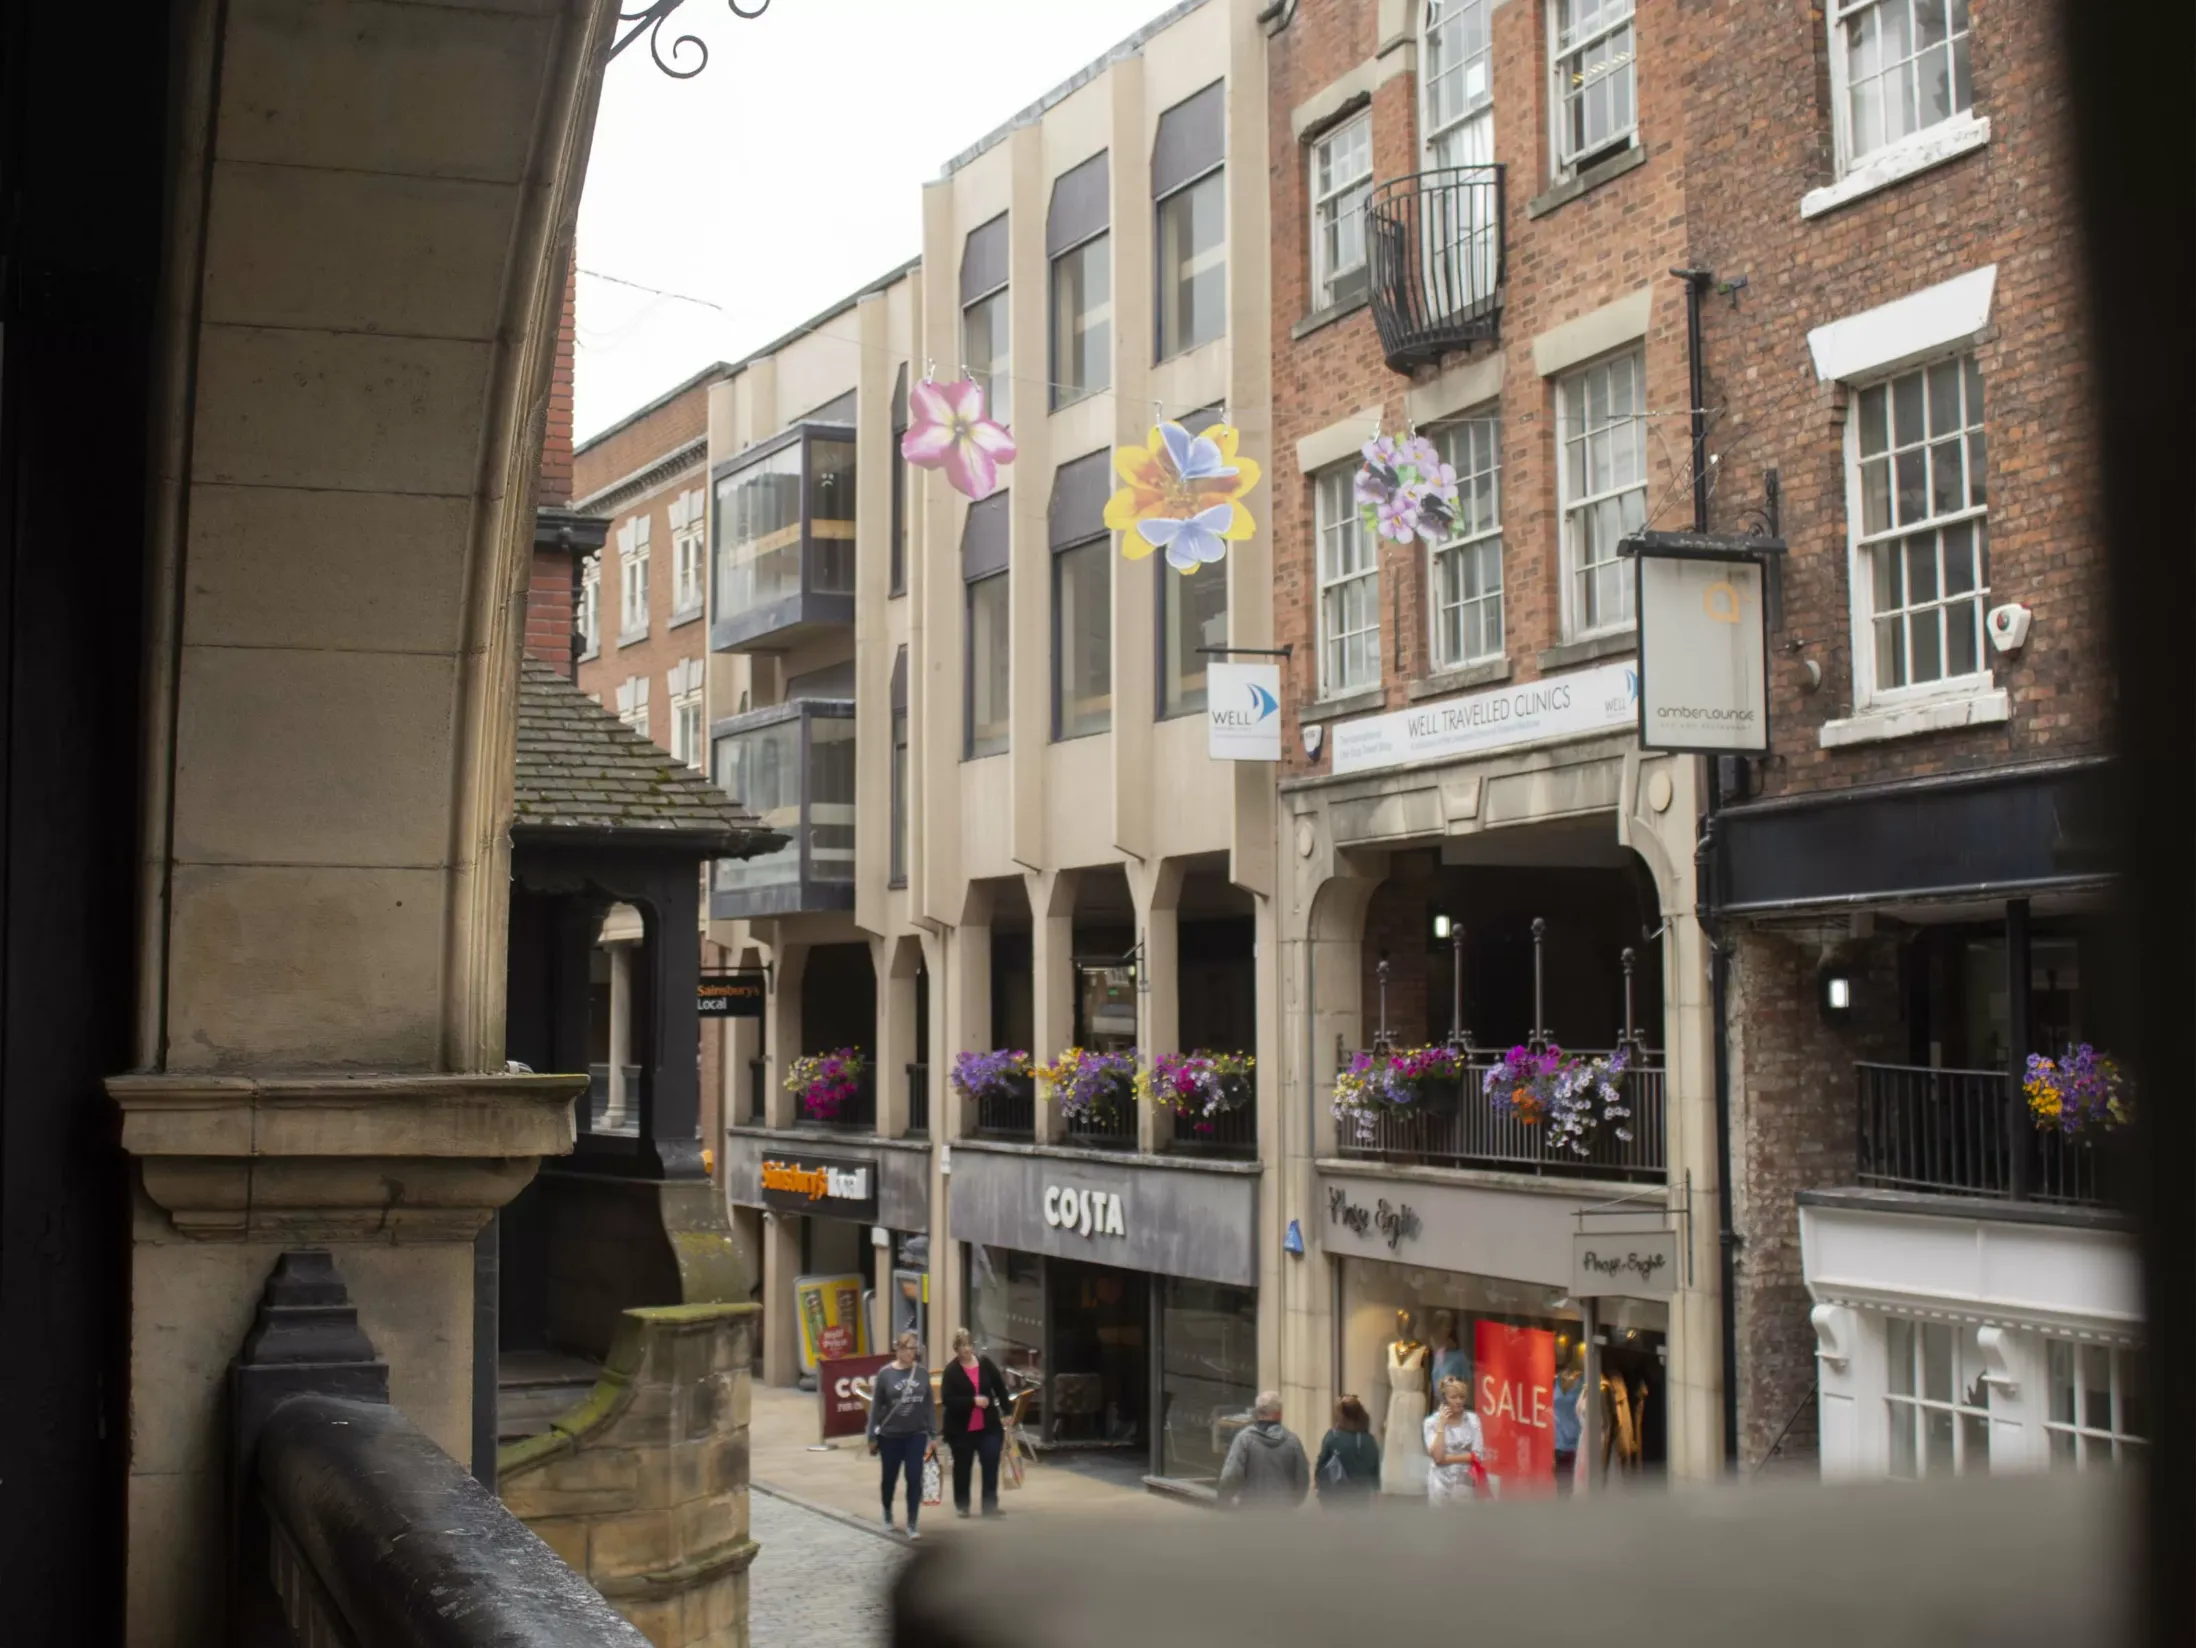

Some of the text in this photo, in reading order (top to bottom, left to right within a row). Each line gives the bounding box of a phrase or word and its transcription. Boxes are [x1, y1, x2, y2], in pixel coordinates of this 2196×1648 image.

[1211, 710, 1252, 726] WELL
[1408, 713, 1439, 738] WELL
[1442, 698, 1510, 731] TRAVELLED
[1514, 684, 1571, 718] CLINICS
[697, 996, 728, 1011] Local
[1043, 1185, 1125, 1237] COSTA
[1481, 1374, 1549, 1429] SALE
